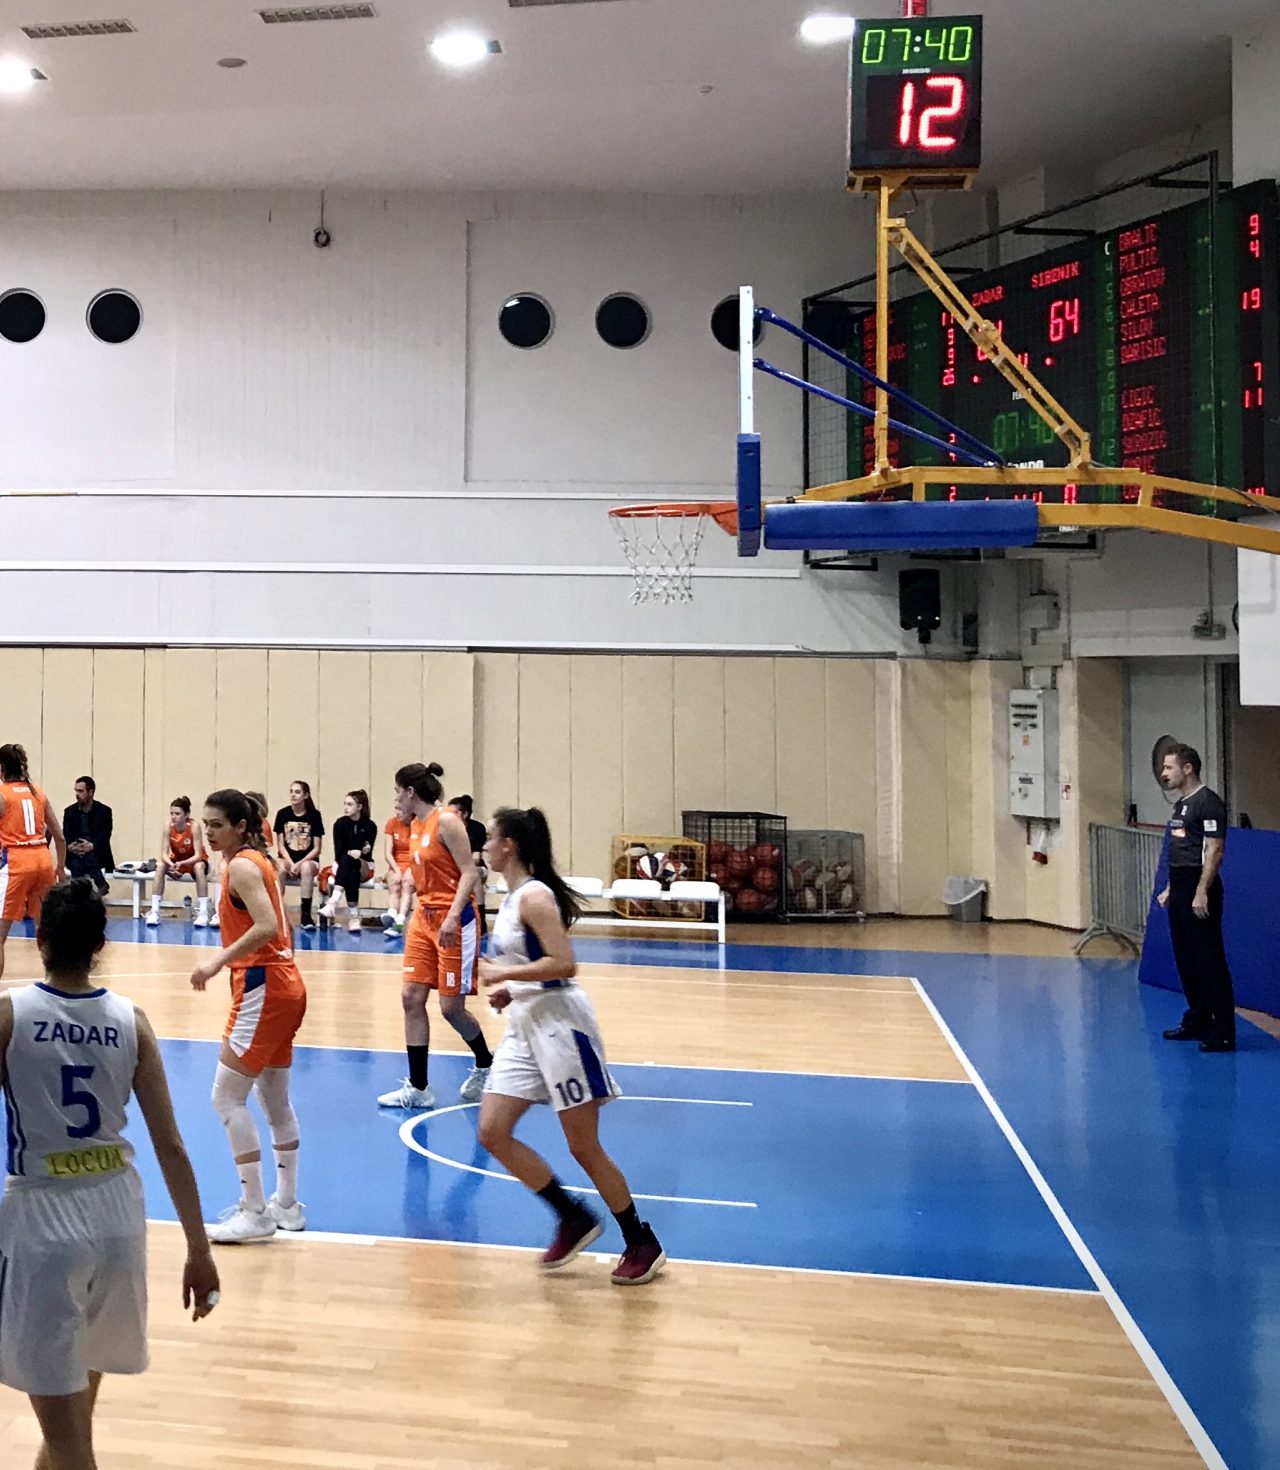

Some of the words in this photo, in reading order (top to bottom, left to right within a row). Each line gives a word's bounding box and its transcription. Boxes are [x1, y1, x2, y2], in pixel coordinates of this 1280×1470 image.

[862, 27, 973, 64] 07:40
[899, 76, 966, 149] 12
[1249, 213, 1260, 236] 9
[1249, 239, 1260, 259] 4
[1031, 260, 1081, 289] SIBENIK
[971, 284, 1004, 308] ZADAR
[1242, 287, 1262, 311] 19
[1049, 298, 1080, 343] 64
[1253, 361, 1263, 382] 7
[1243, 386, 1263, 409] 11
[21, 798, 37, 835] 11
[33, 1021, 120, 1049] ZADAR
[60, 1064, 101, 1139] 5
[554, 1078, 584, 1107] 10
